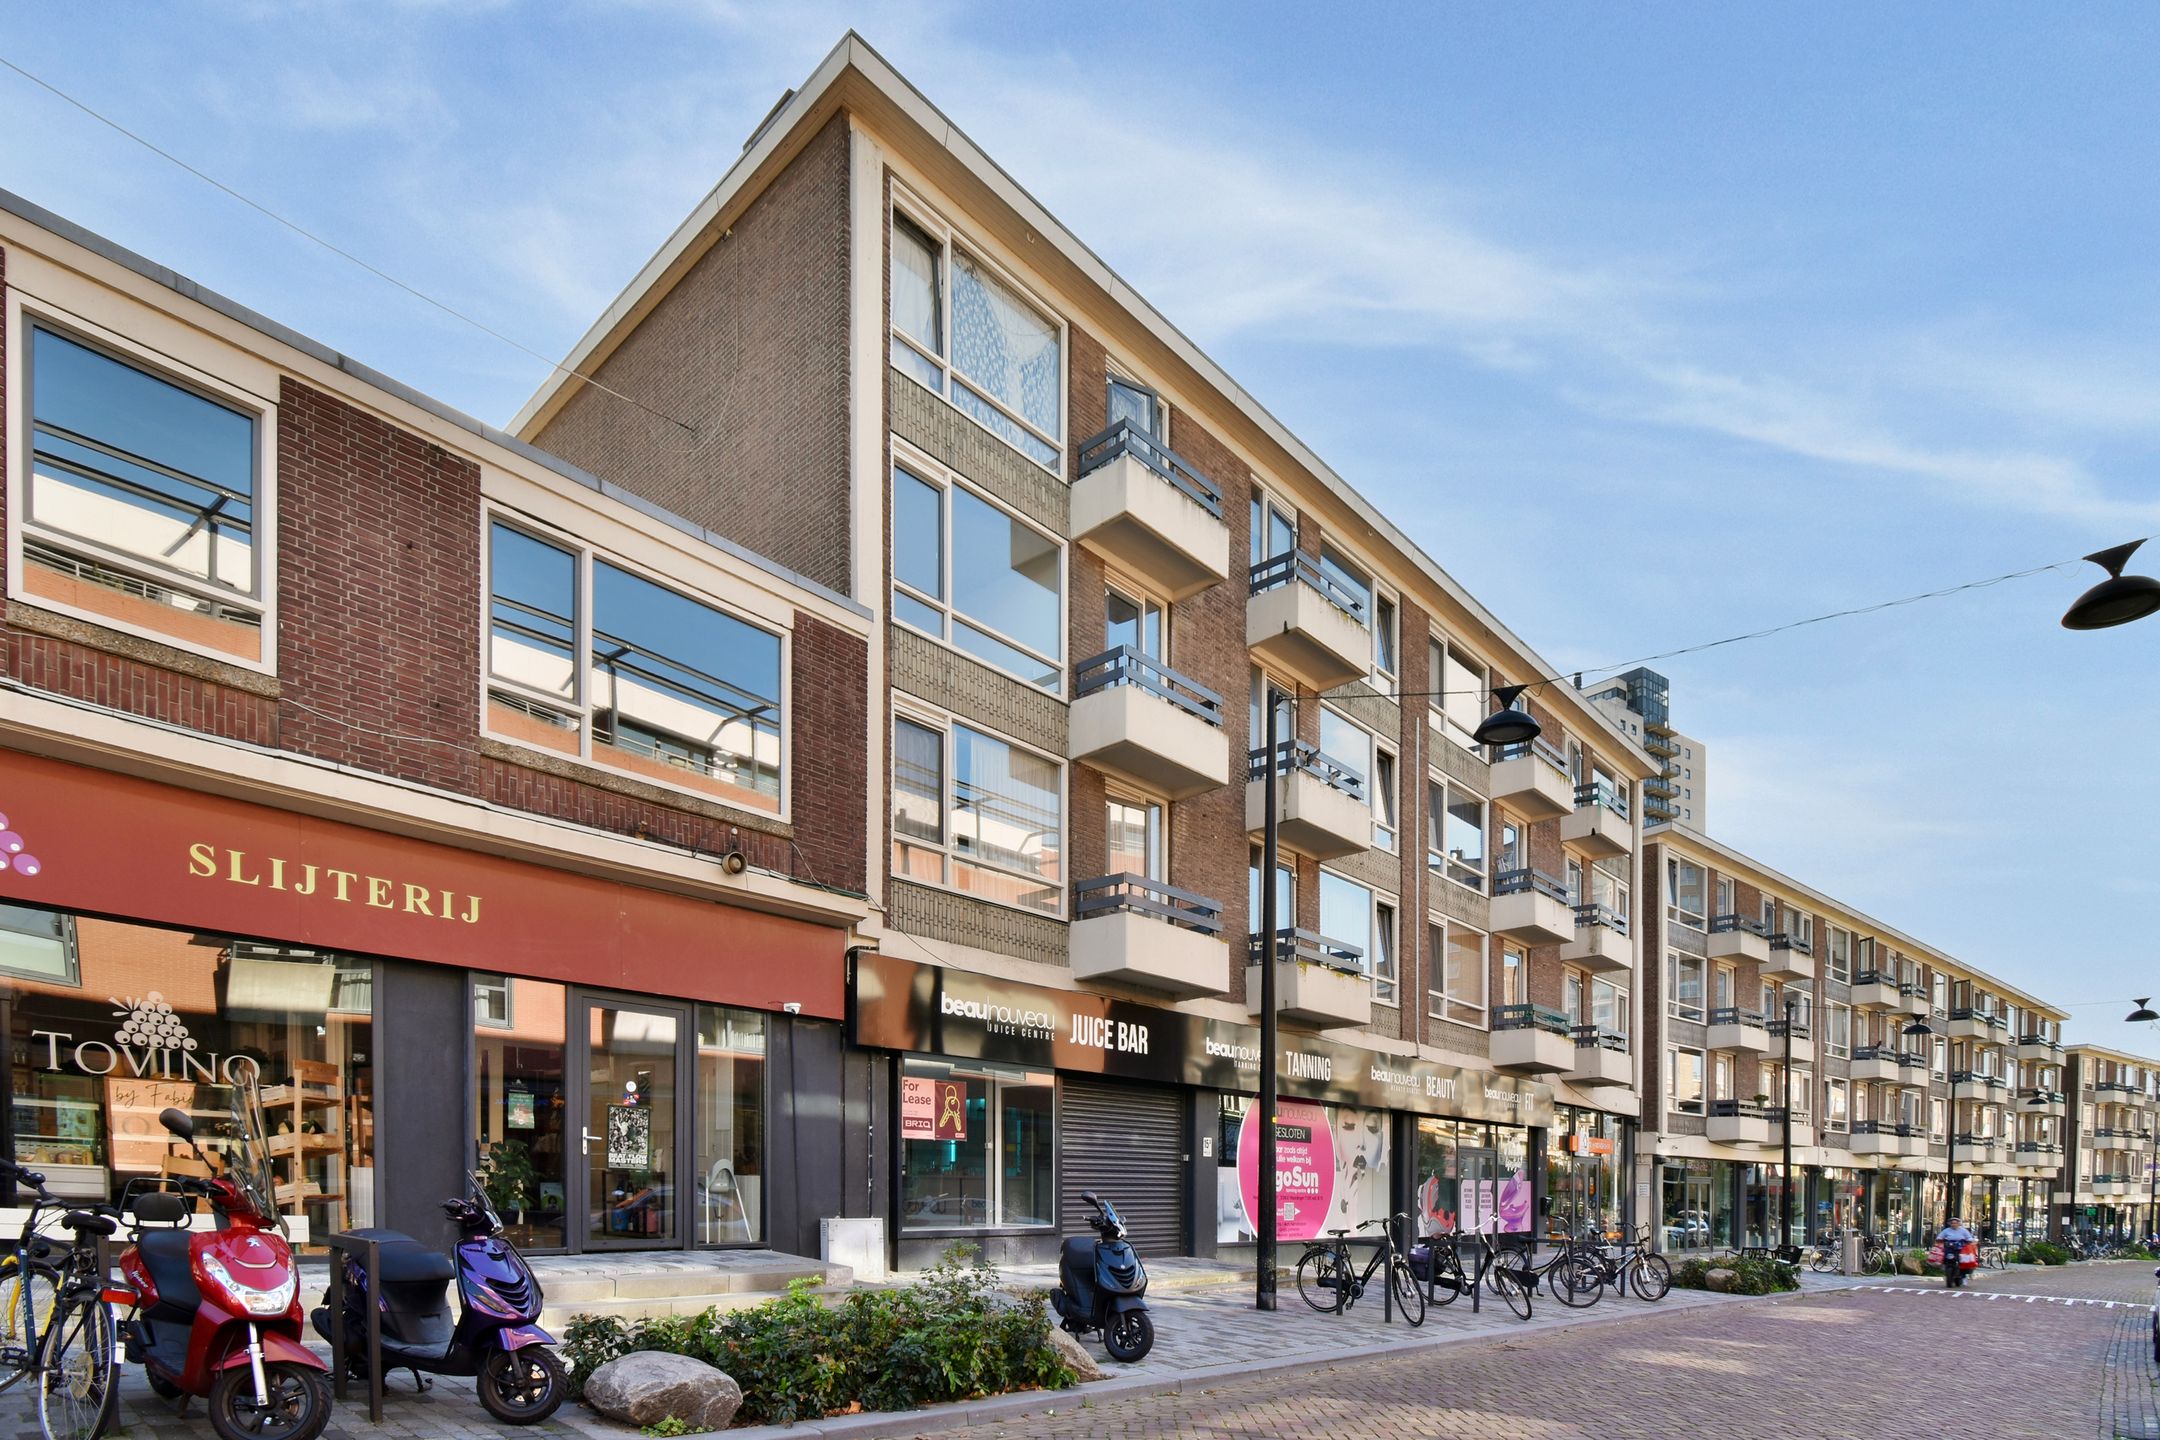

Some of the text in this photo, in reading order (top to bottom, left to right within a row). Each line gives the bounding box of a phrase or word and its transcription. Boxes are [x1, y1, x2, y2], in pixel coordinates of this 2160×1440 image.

[189, 843, 483, 923] SLIJTERIJ
[988, 1023, 1055, 1042] JUICE CENTRE
[1070, 1014, 1149, 1055] JUICE BAR
[31, 1029, 260, 1087] TOVINO
[1286, 1050, 1331, 1081] TANNING
[903, 1080, 919, 1091] For
[1426, 1075, 1456, 1100] BEAUTY
[903, 1092, 931, 1105] Lease
[1525, 1093, 1535, 1112] FIT
[905, 1119, 931, 1129] BRIQ
